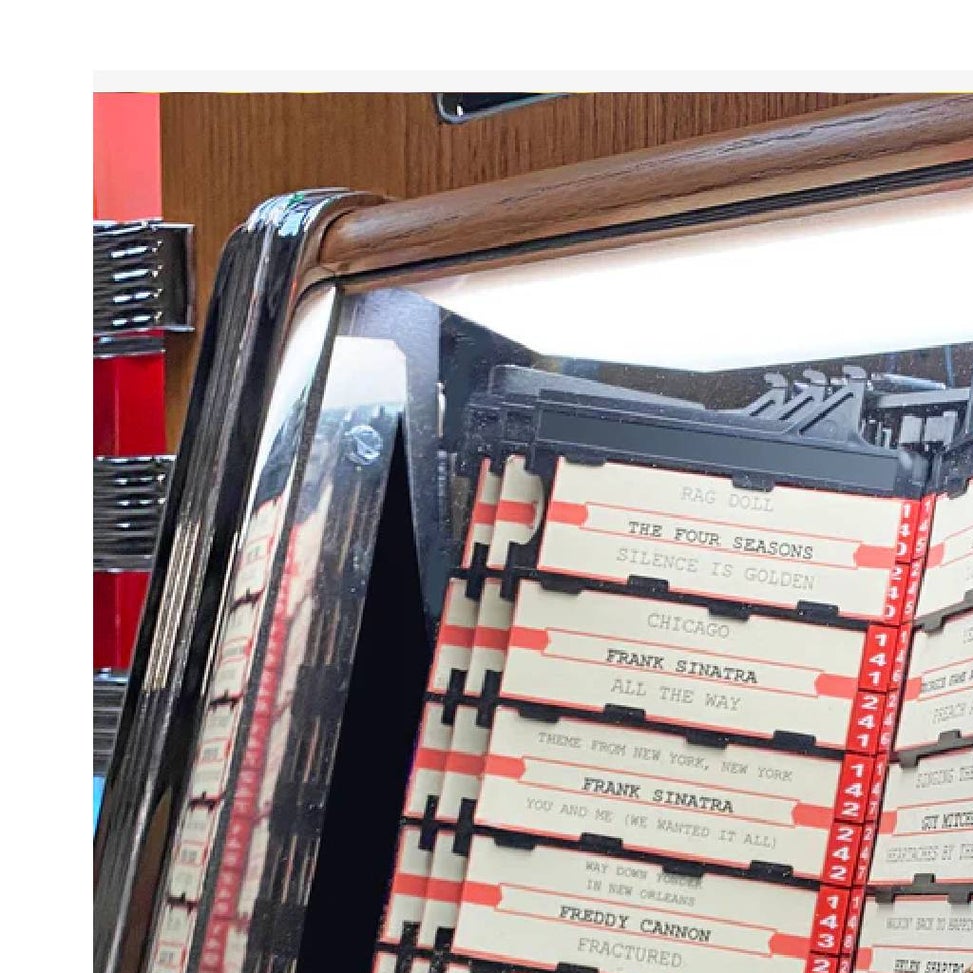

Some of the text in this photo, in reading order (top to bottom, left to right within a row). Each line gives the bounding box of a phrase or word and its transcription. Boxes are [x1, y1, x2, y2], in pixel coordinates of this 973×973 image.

[680, 485, 774, 513] RAG DOLL
[628, 520, 814, 560] THE FOUR SEASONS
[616, 547, 815, 591] SILENCE IS GOLDEN
[647, 612, 730, 639] CHICAGO
[606, 648, 758, 685] FRANK SINATRA
[868, 631, 889, 685] 141
[610, 678, 742, 711] ALL THE WAY
[856, 695, 878, 749] 241
[538, 731, 794, 783] THEME FROM NEW YORK, NEW YORK
[581, 776, 736, 814] FRANK SINATRA
[842, 763, 864, 817] 142
[525, 797, 778, 850] YOU AND ME (WE WANTED IT ALL)
[585, 861, 609, 876] WAY
[615, 865, 647, 882] DOWN
[829, 827, 854, 880] 242
[586, 880, 697, 908] IN NEW ORLEANS
[559, 905, 712, 943] FREDDY CANNON
[816, 895, 840, 948] 143
[577, 936, 683, 968] FRACTURED
